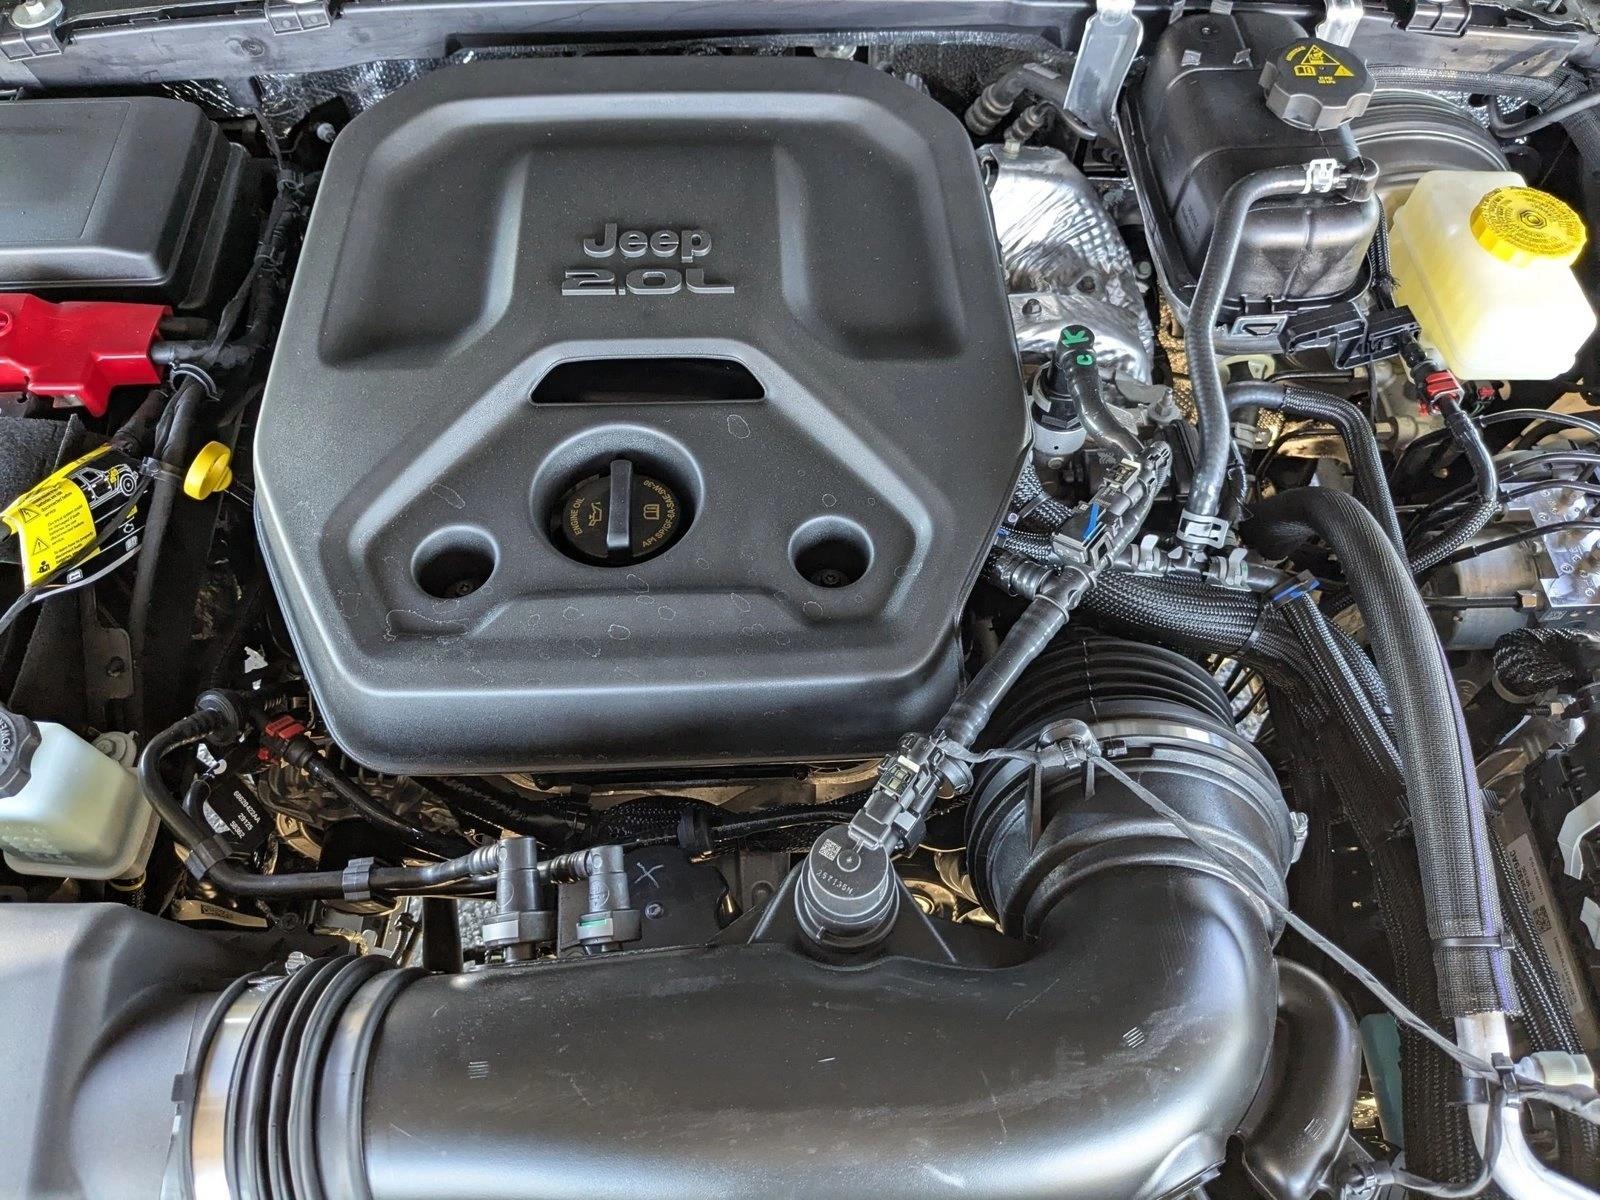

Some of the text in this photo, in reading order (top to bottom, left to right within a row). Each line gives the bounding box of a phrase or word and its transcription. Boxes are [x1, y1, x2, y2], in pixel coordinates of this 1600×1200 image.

[583, 222, 712, 263] Jeep
[562, 268, 735, 296] 2.0L
[570, 497, 585, 536] ENGINE OIL
[642, 535, 657, 548] API
